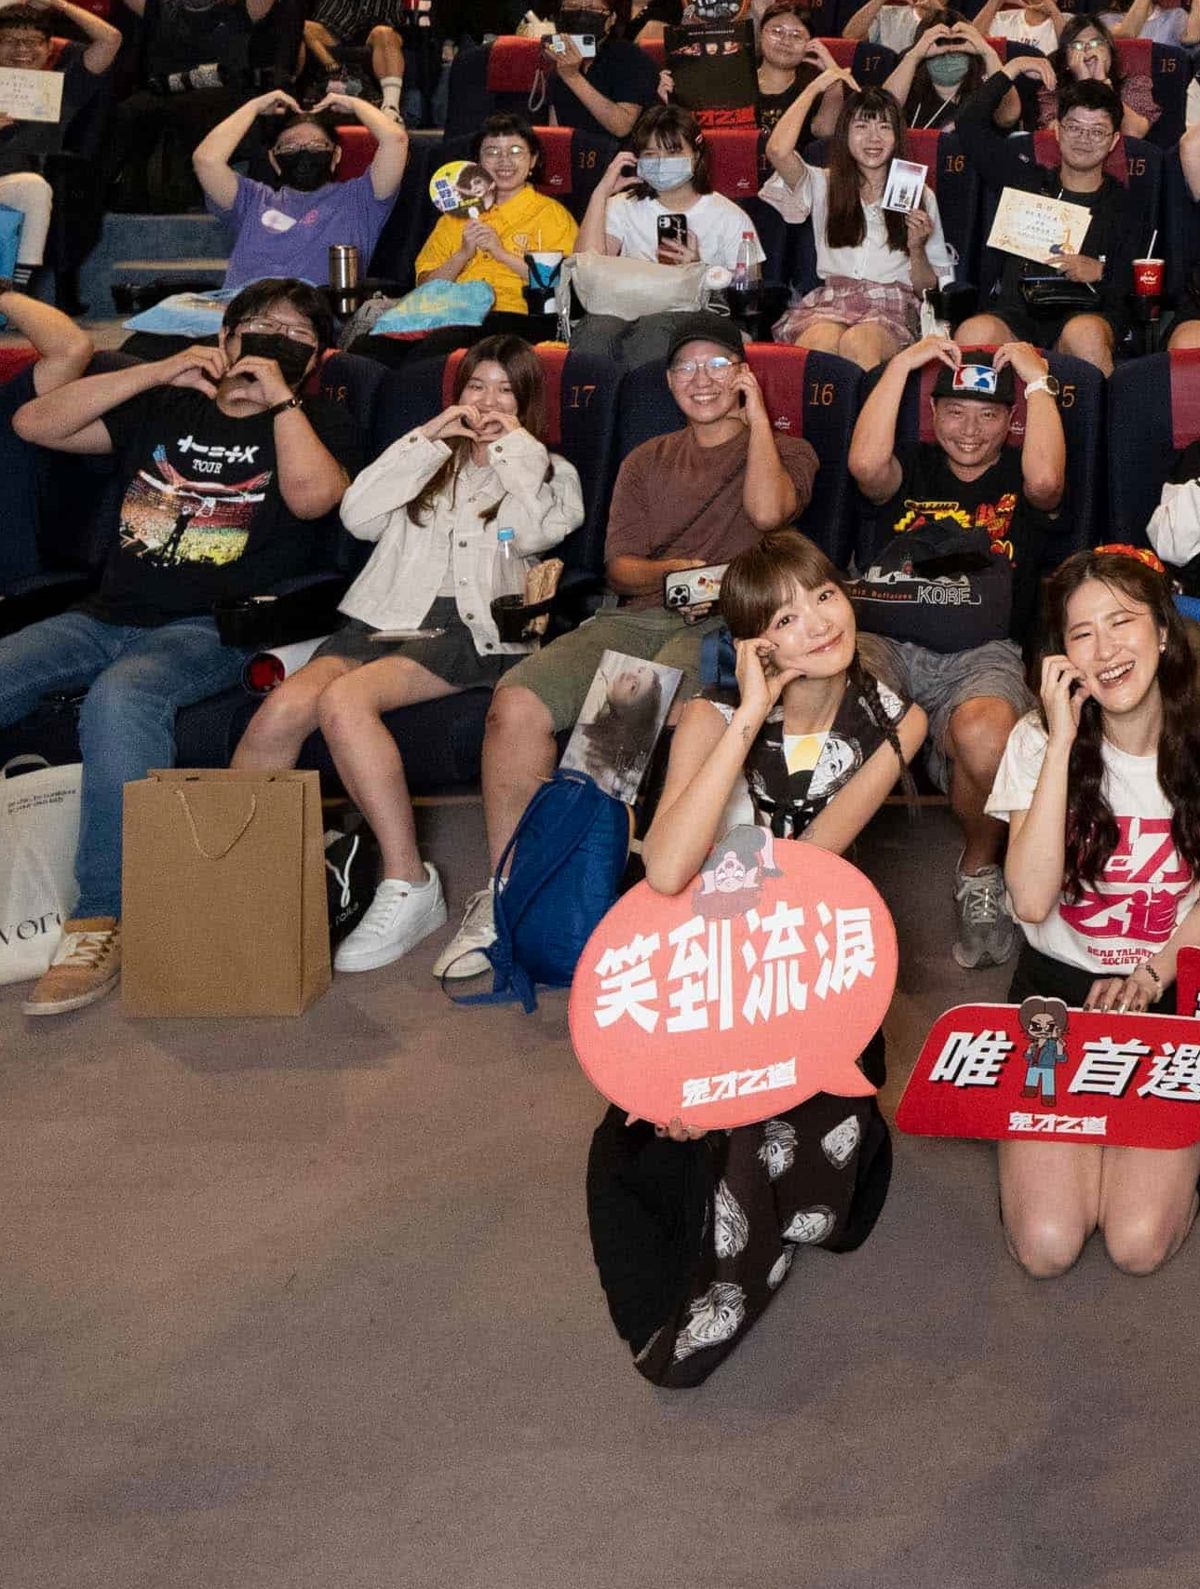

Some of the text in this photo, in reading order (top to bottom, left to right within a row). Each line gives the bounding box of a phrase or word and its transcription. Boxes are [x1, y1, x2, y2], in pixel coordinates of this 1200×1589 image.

[863, 56, 881, 72] 17
[1160, 58, 1176, 73] 15
[945, 154, 966, 172] 16
[1127, 159, 1147, 176] 15
[571, 384, 597, 408] 17
[809, 382, 834, 406] 16
[192, 458, 223, 474] TOUR
[917, 585, 971, 606] KOBE
[1101, 956, 1142, 966] SOCIETY
[1115, 949, 1154, 960] TALENT
[593, 900, 878, 1034] 笑到流淚
[928, 1029, 1014, 1088] 唯
[681, 1056, 797, 1108] 鬼才之道
[1008, 1111, 1108, 1136] 鬼才之道
